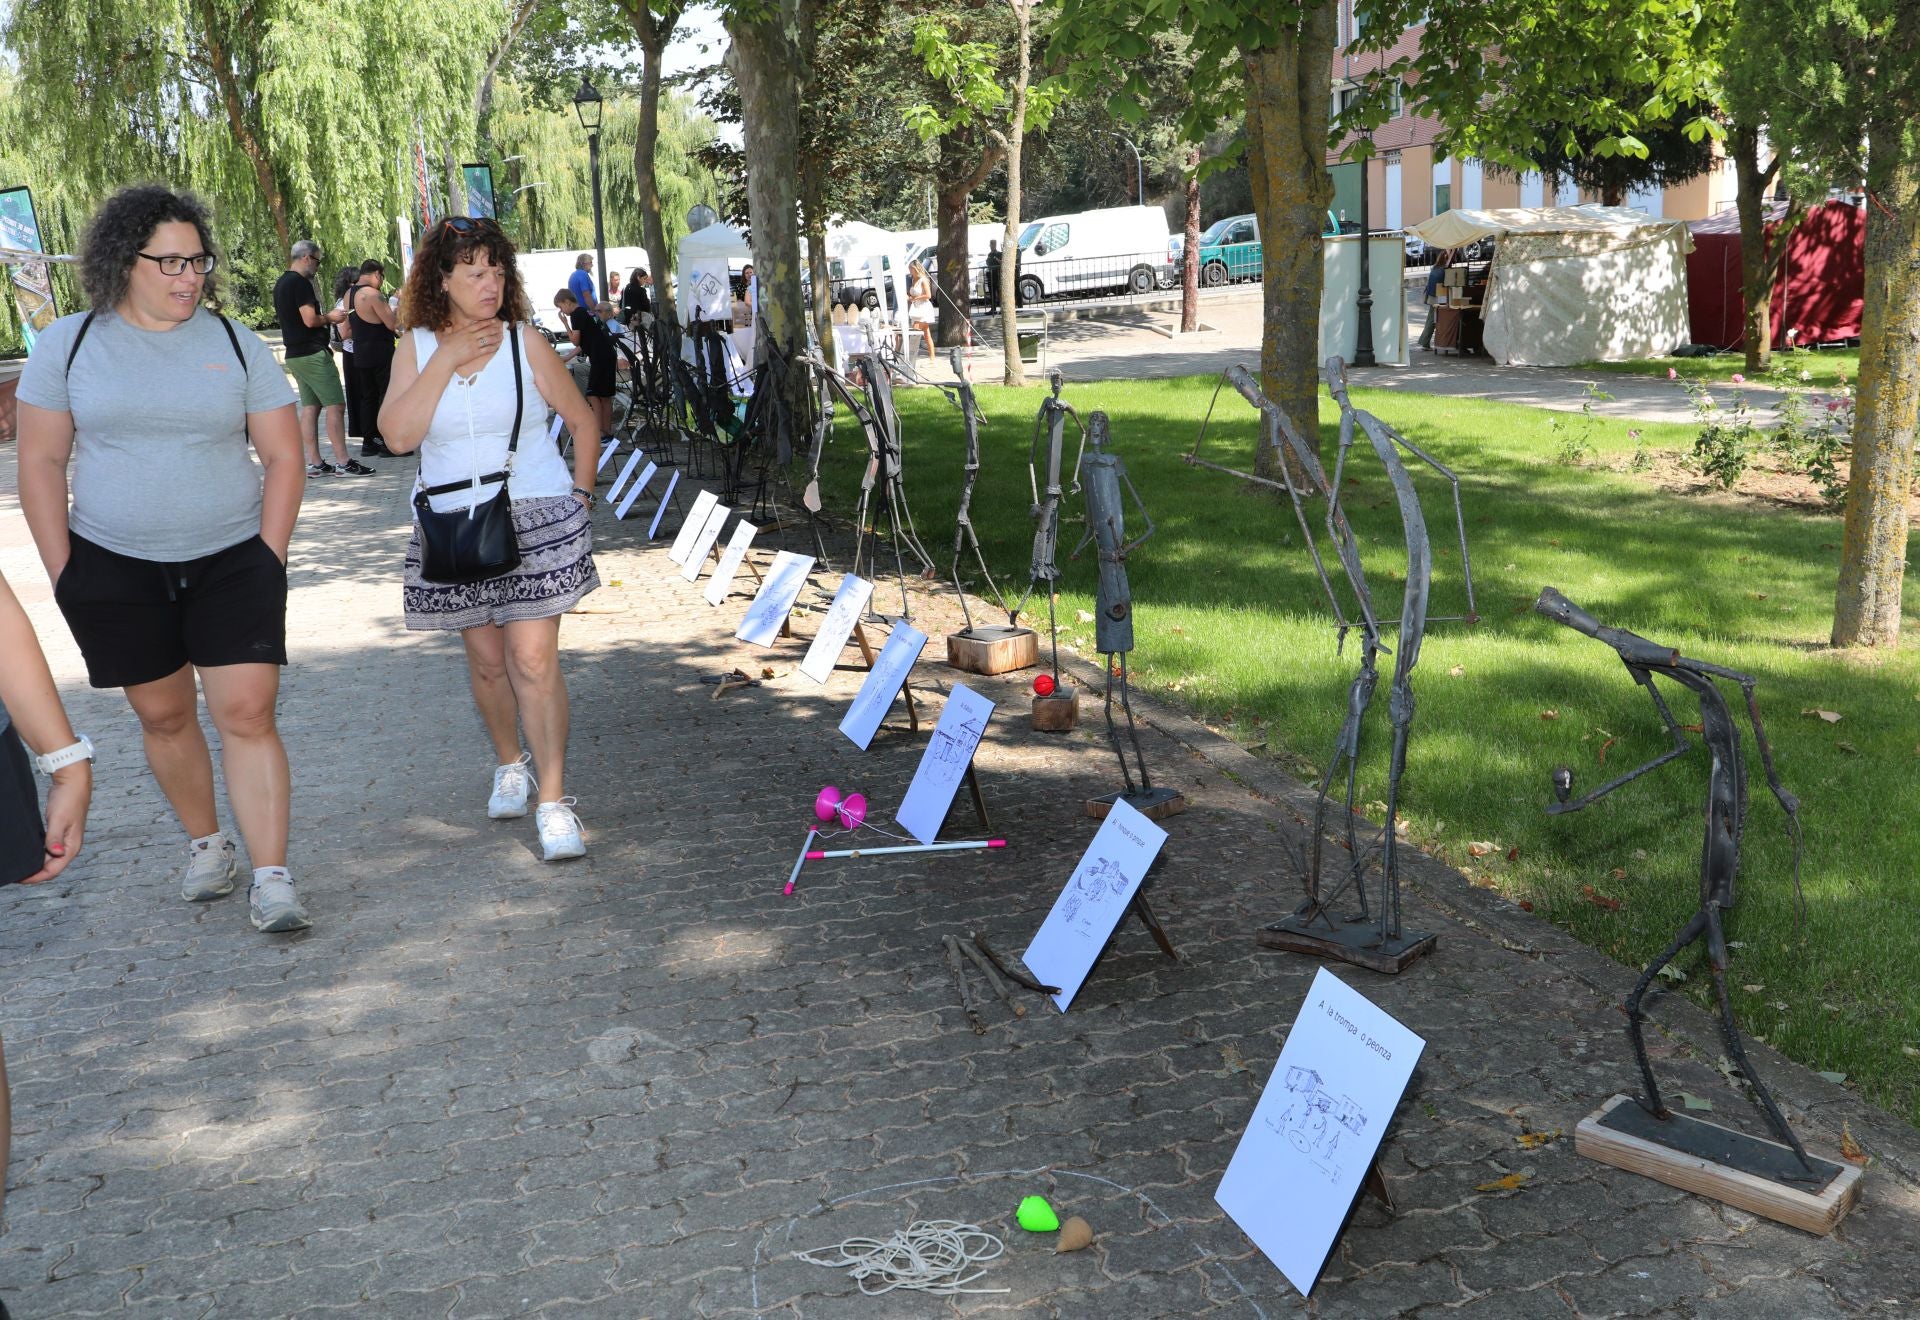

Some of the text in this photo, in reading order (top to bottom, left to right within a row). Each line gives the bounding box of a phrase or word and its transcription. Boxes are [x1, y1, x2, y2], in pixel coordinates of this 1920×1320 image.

[1318, 1000, 1392, 1061] A la trompa o peonza
